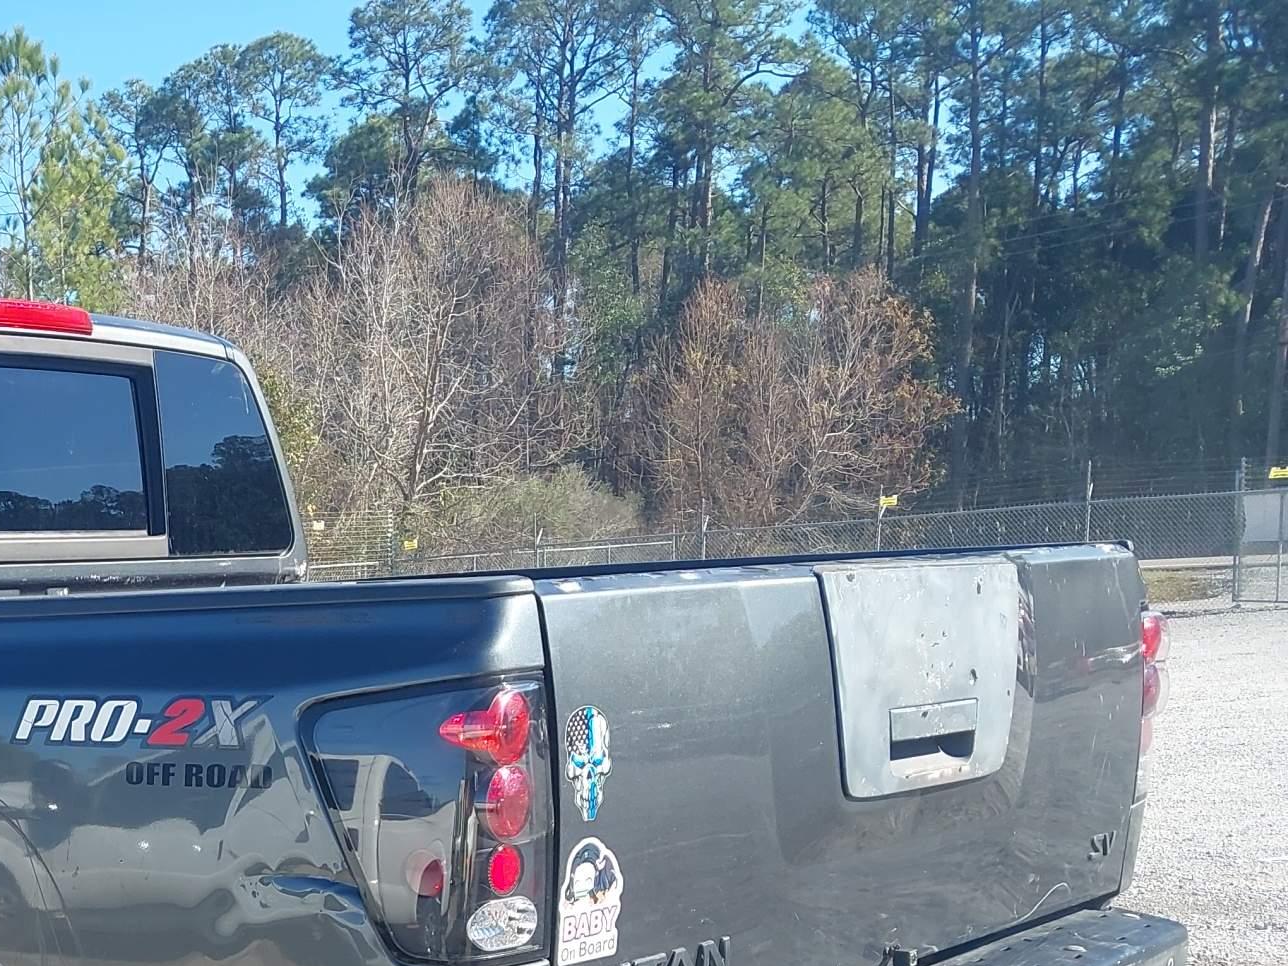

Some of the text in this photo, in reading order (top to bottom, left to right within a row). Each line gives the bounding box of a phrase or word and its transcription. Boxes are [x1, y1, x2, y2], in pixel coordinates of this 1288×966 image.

[13, 697, 265, 747] PRO-2X
[125, 761, 273, 789] OFF ROAD
[1088, 830, 1117, 860] SV
[562, 905, 617, 943] BABY
[561, 935, 615, 961] On Board
